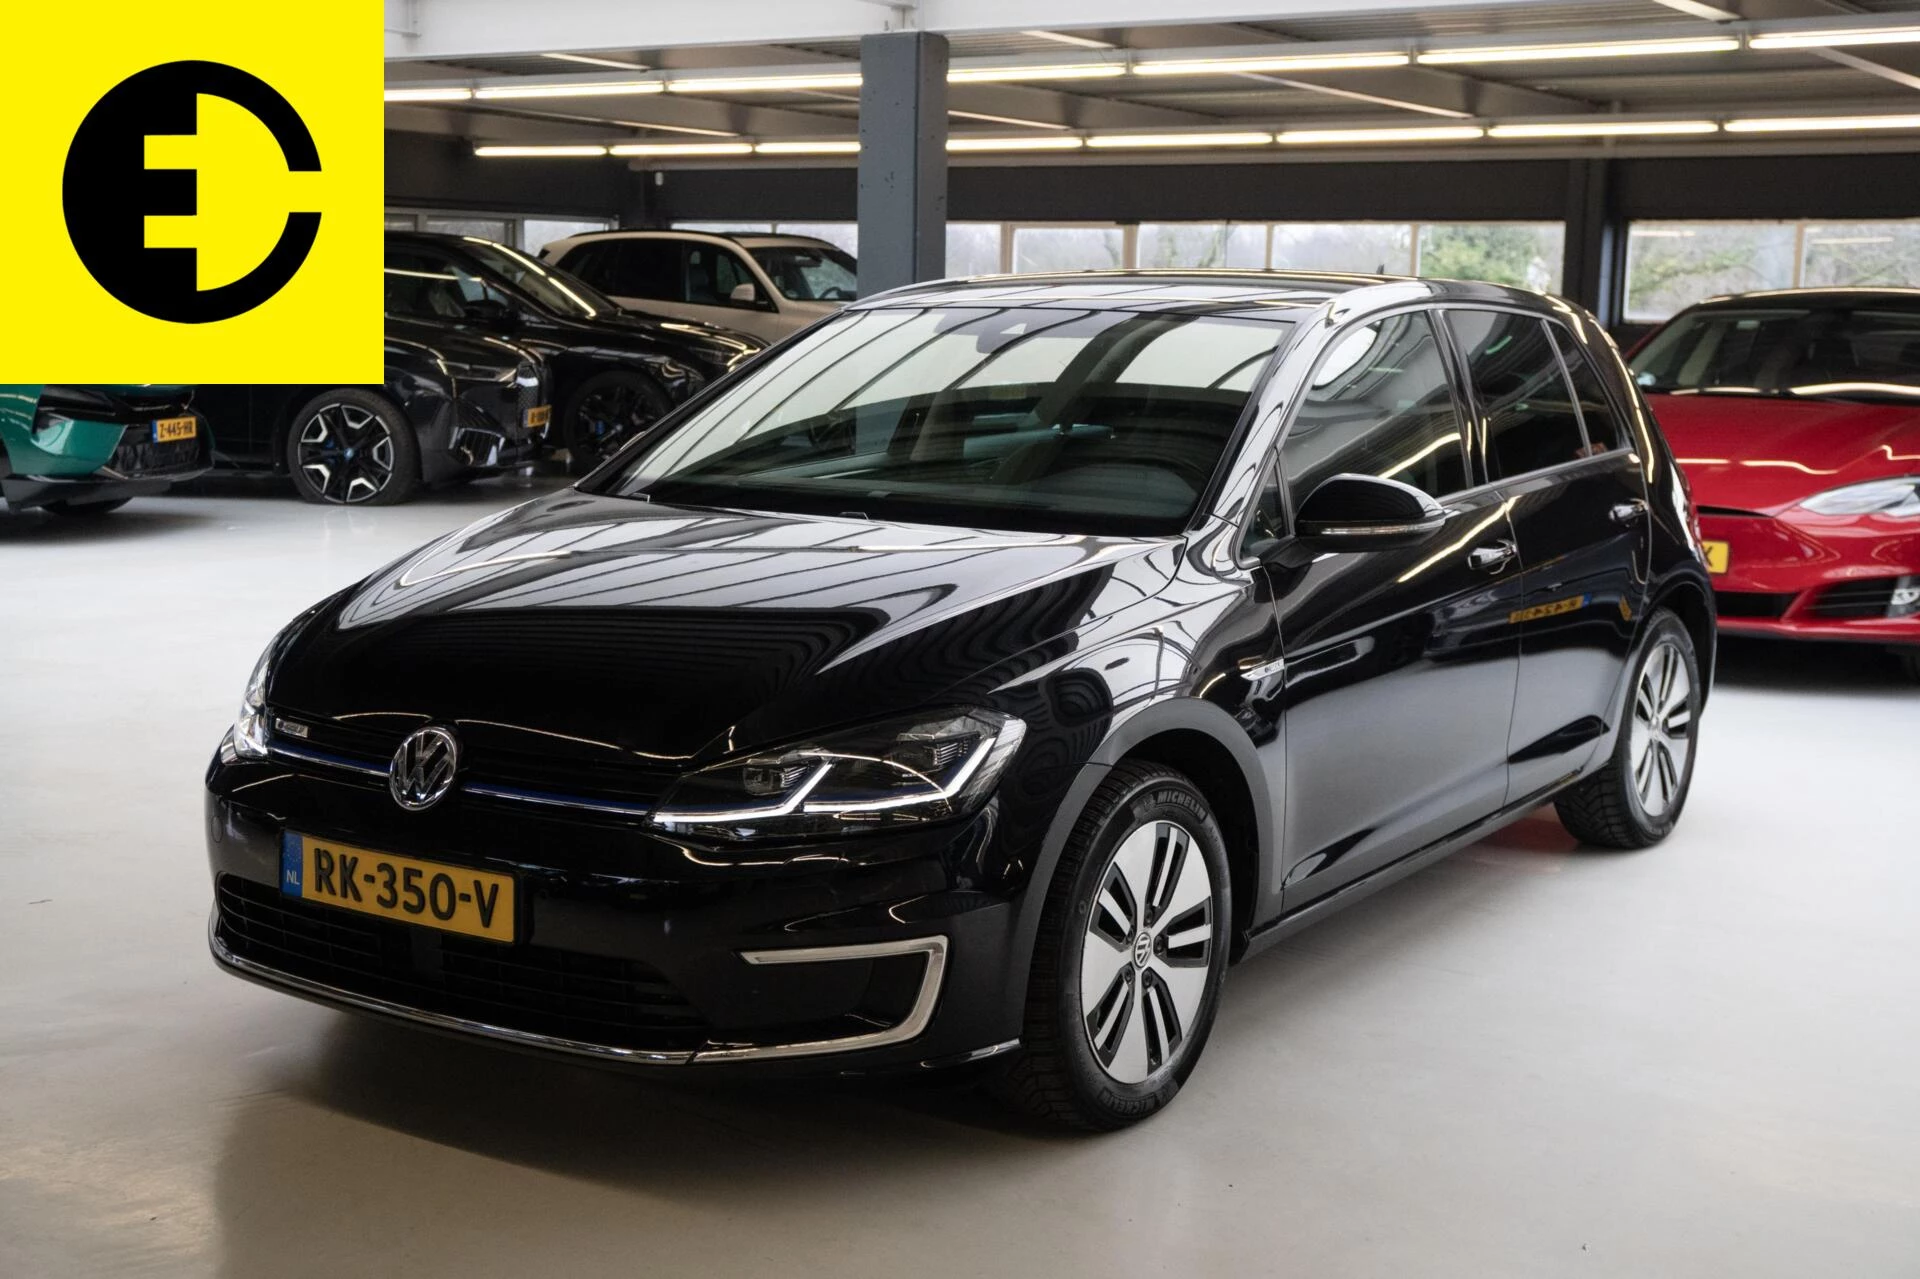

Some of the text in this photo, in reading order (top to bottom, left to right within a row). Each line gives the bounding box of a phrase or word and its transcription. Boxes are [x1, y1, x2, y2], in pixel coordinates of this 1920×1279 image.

[1157, 790, 1207, 820] MICHELIN
[286, 870, 300, 885] NL
[314, 848, 499, 928] RK-350-V
